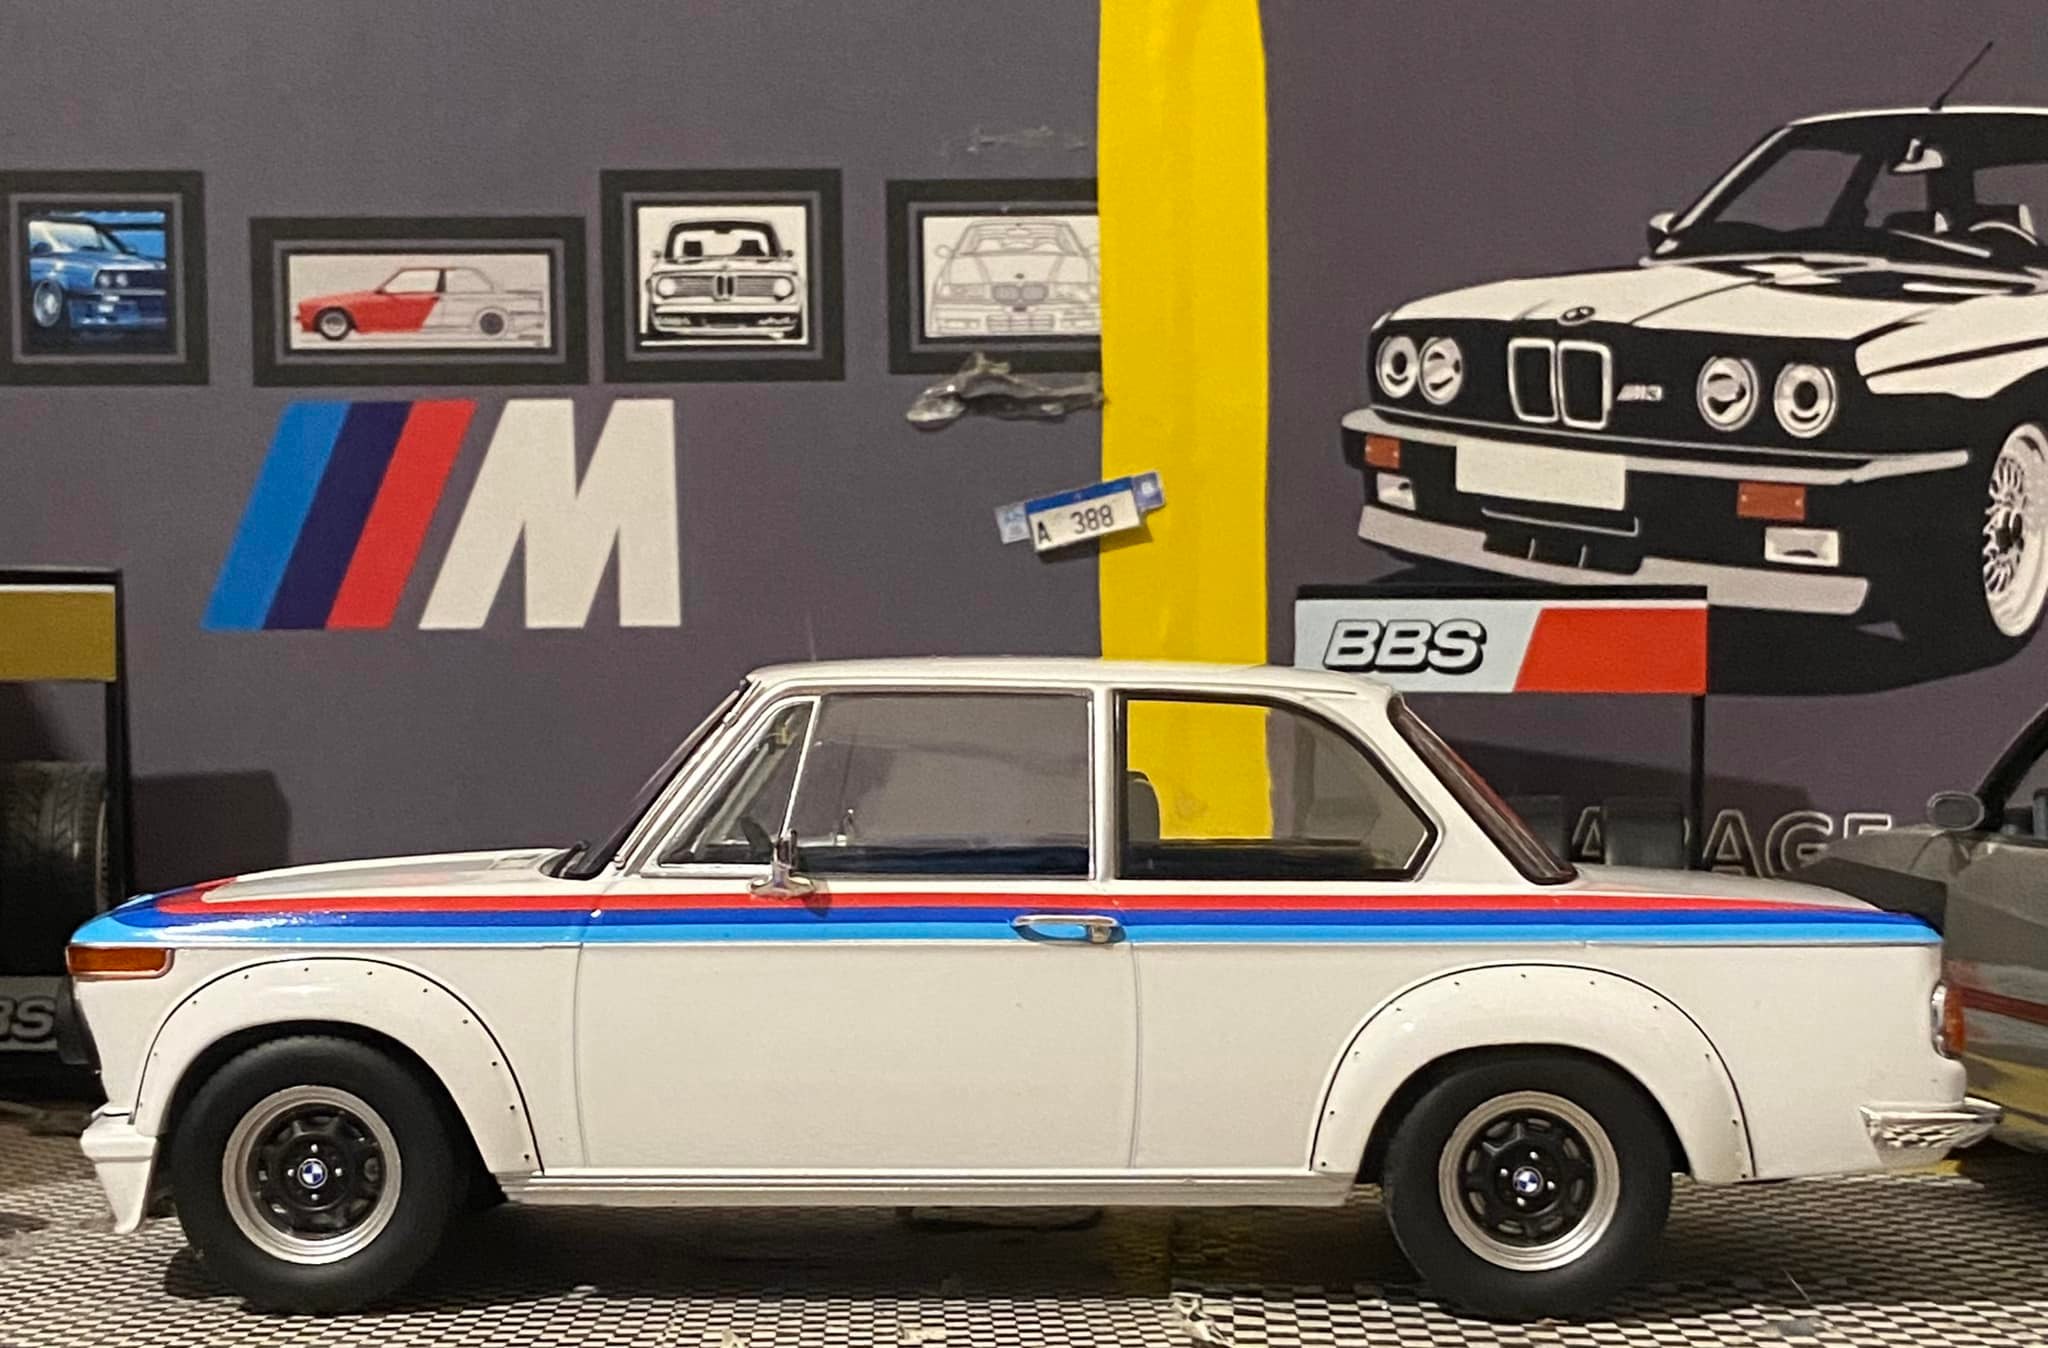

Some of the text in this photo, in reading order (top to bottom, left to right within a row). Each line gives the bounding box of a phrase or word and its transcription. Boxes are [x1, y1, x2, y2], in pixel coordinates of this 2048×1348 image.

[1036, 504, 1115, 545] A 388
[1322, 618, 1487, 676] BBS
[0, 995, 57, 1043] S
